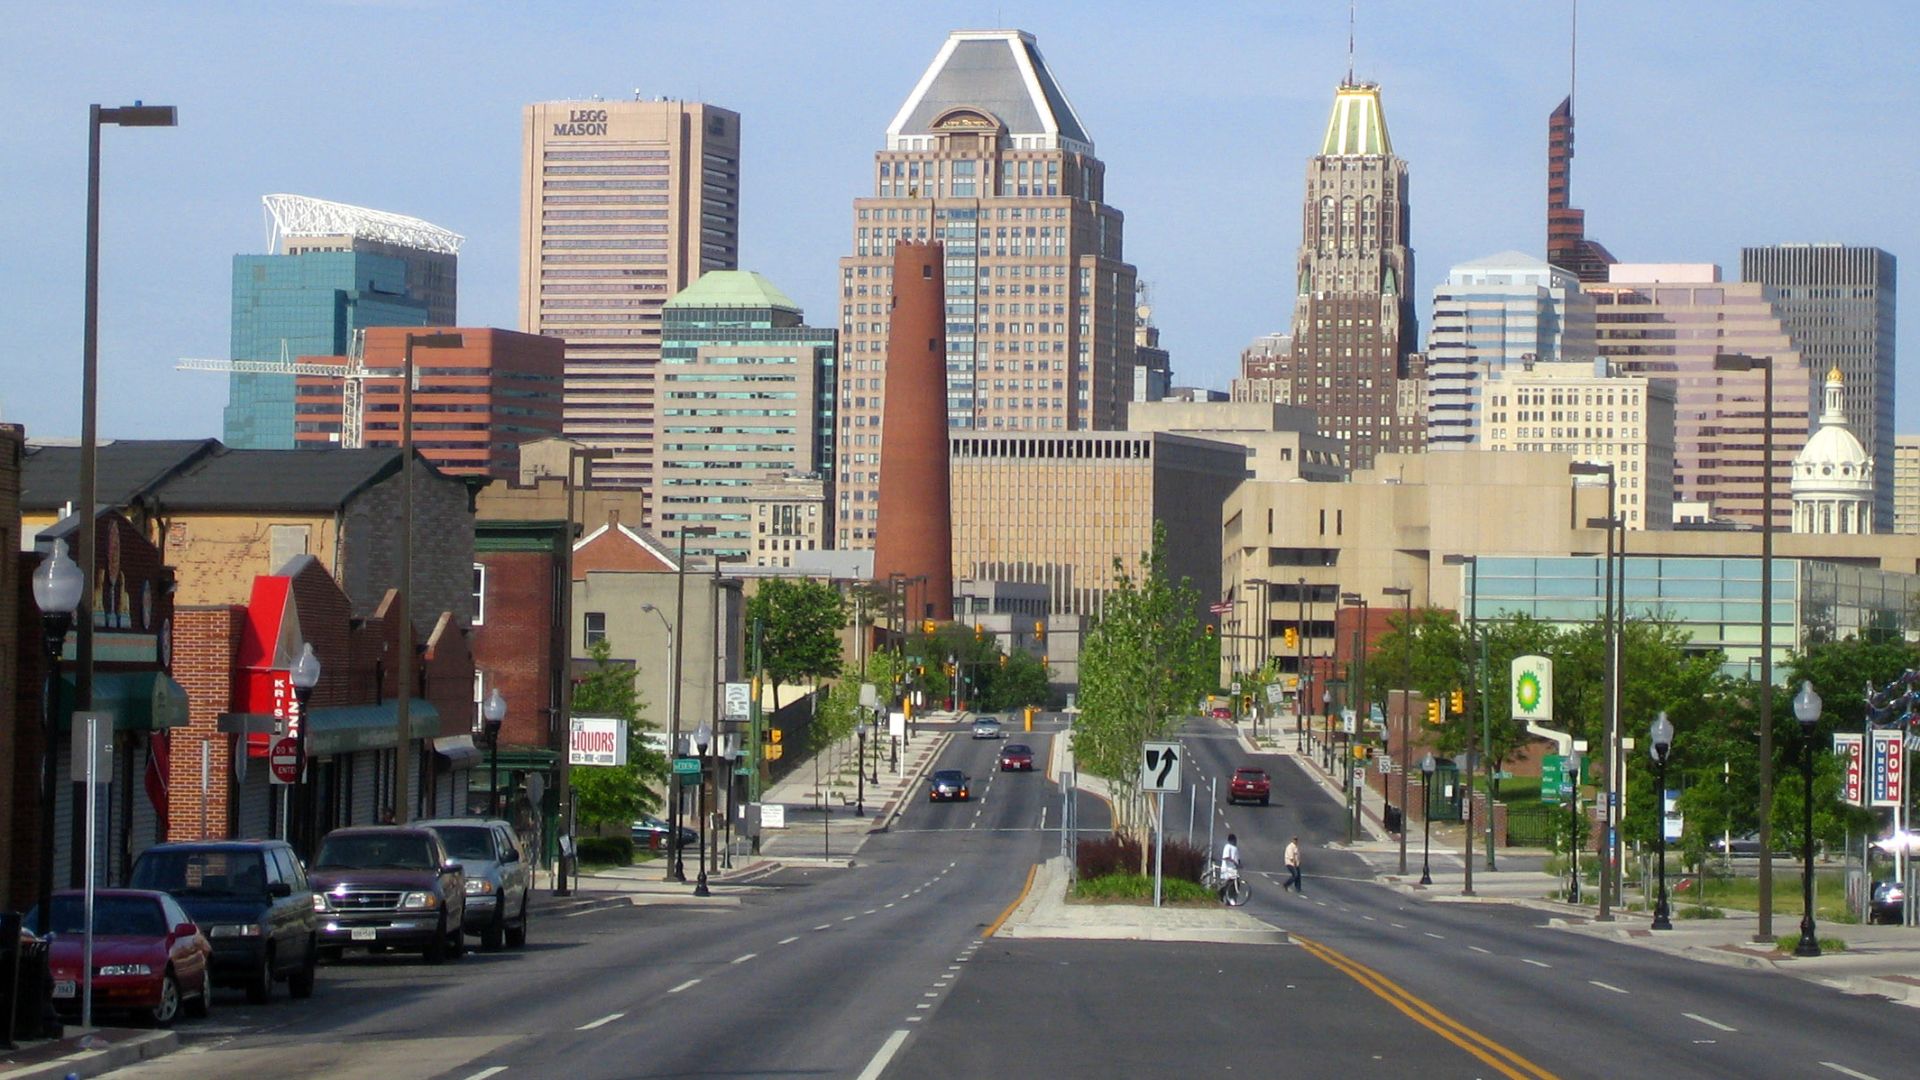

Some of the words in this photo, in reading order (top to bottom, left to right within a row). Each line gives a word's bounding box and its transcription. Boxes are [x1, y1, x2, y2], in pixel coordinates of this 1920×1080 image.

[553, 123, 608, 136] MASON
[570, 110, 608, 122] LEGG
[274, 679, 285, 717] KRIS
[571, 731, 615, 753] LIQUORS
[1849, 745, 1859, 799] CARS
[1877, 757, 1885, 798] MONEY
[1888, 744, 1899, 797] DOWN
